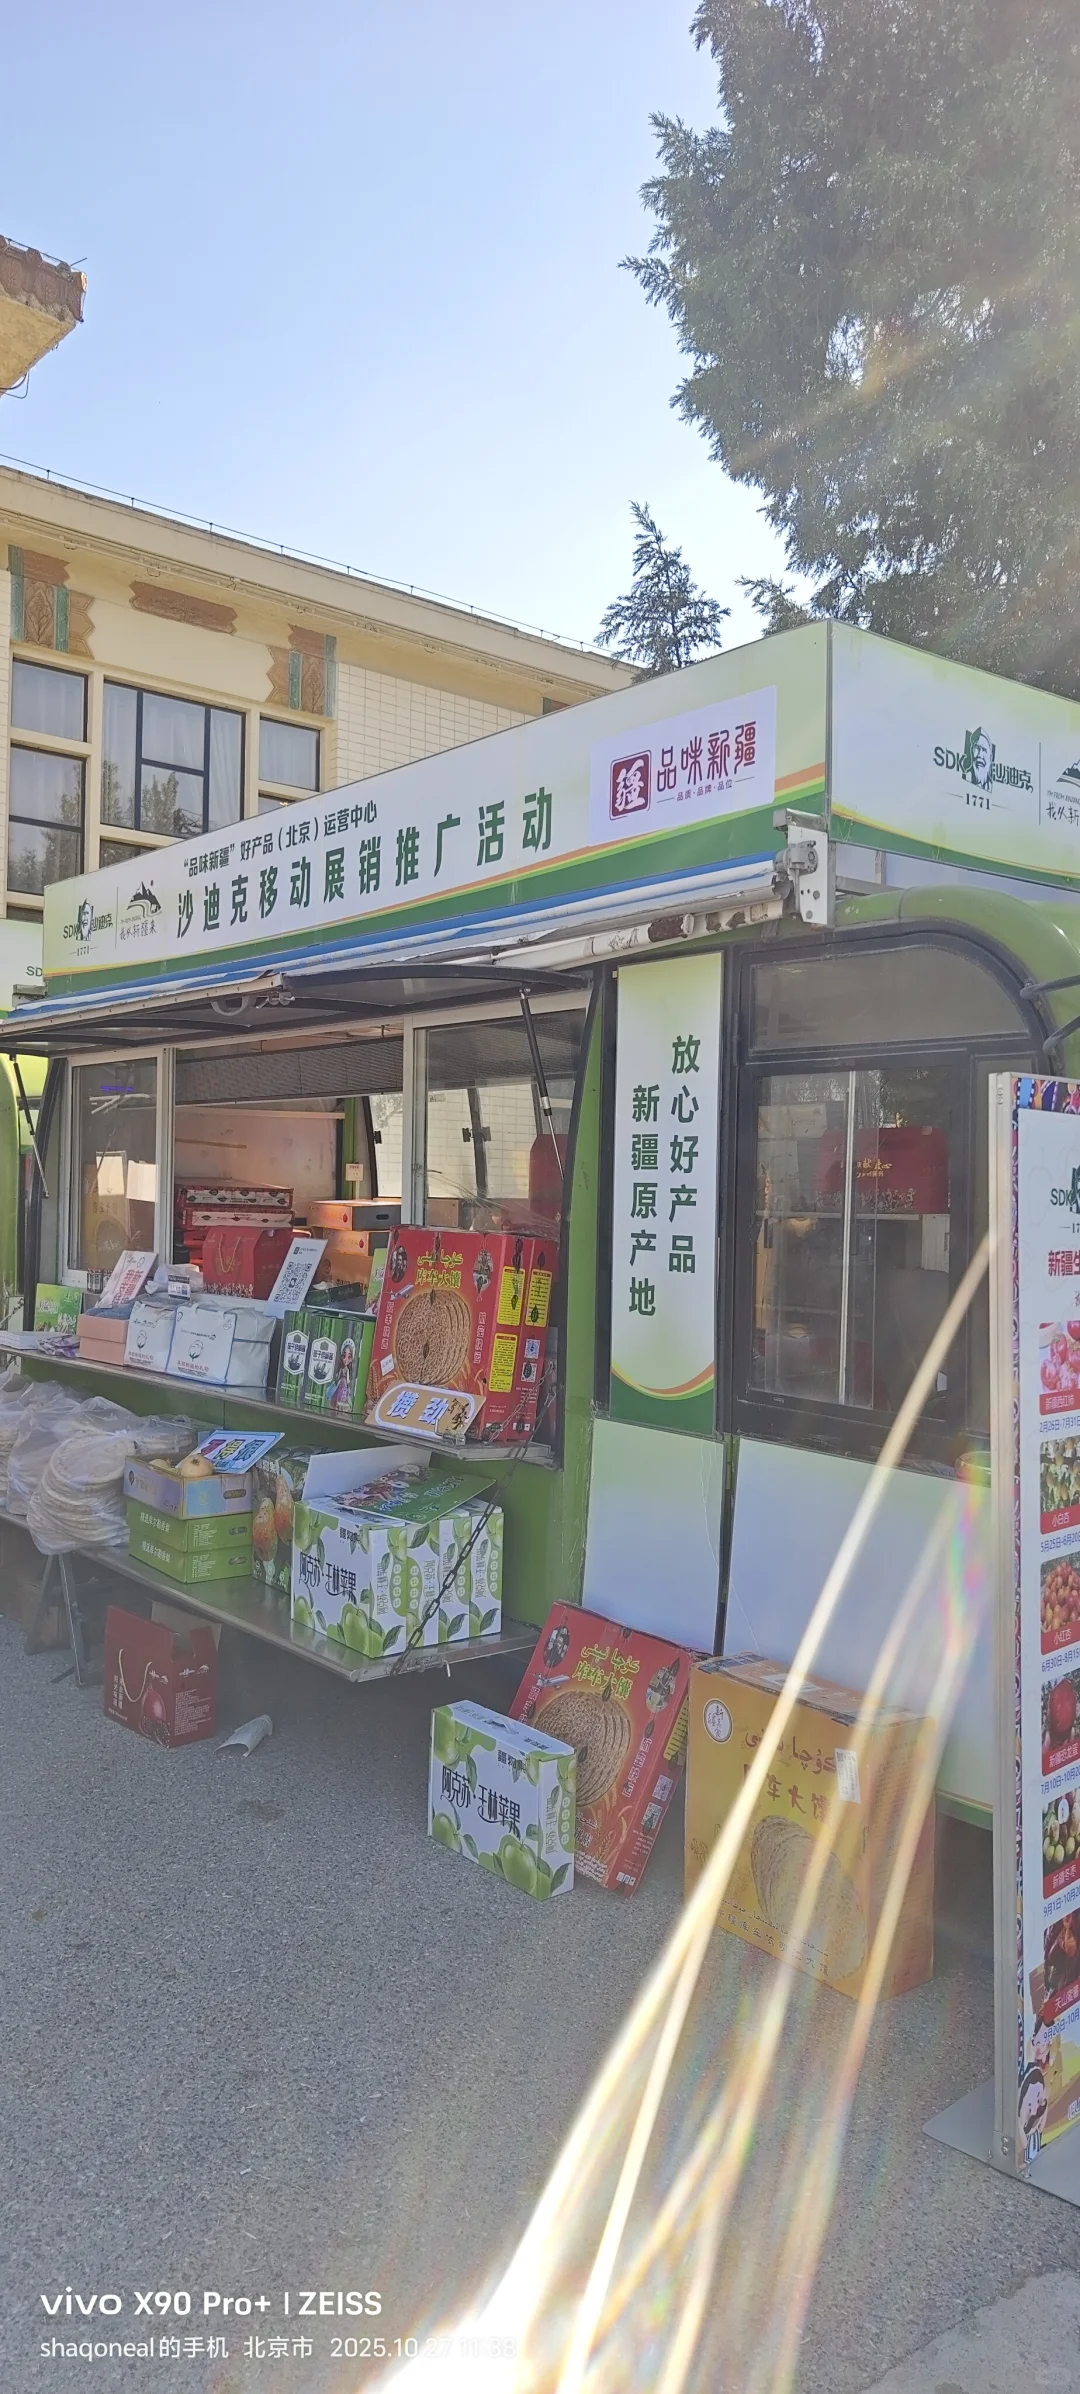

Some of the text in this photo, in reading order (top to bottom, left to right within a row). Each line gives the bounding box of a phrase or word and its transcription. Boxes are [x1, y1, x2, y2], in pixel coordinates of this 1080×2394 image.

[656, 720, 757, 793] 品味新疆
[965, 793, 990, 810] 1771
[177, 787, 553, 939] 沙迪克移动展销推广活动
[77, 946, 90, 957] 1771
[628, 1084, 660, 1317] 新疆原产地
[668, 1034, 701, 1274] 放心好产品
